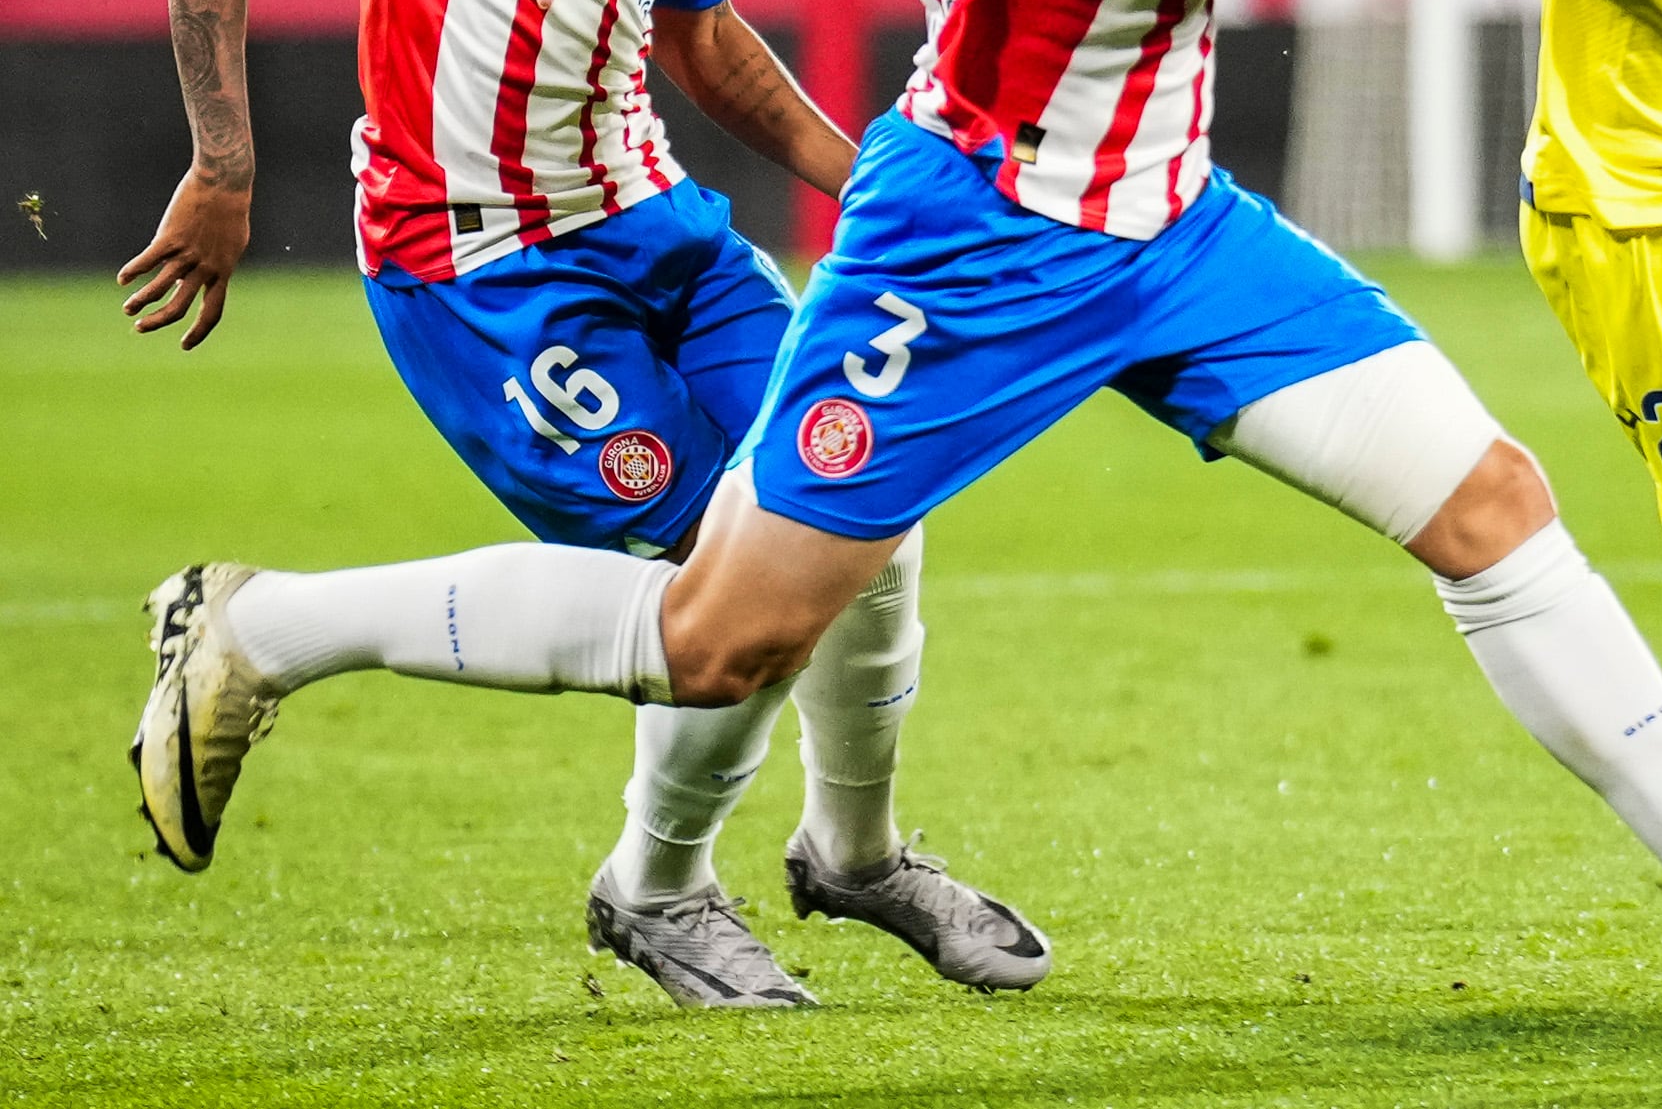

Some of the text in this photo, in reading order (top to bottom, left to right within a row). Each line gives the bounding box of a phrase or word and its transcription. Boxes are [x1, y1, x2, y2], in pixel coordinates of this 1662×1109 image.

[843, 291, 928, 398] 3
[503, 345, 620, 455] 16
[604, 436, 640, 469] GIRONA
